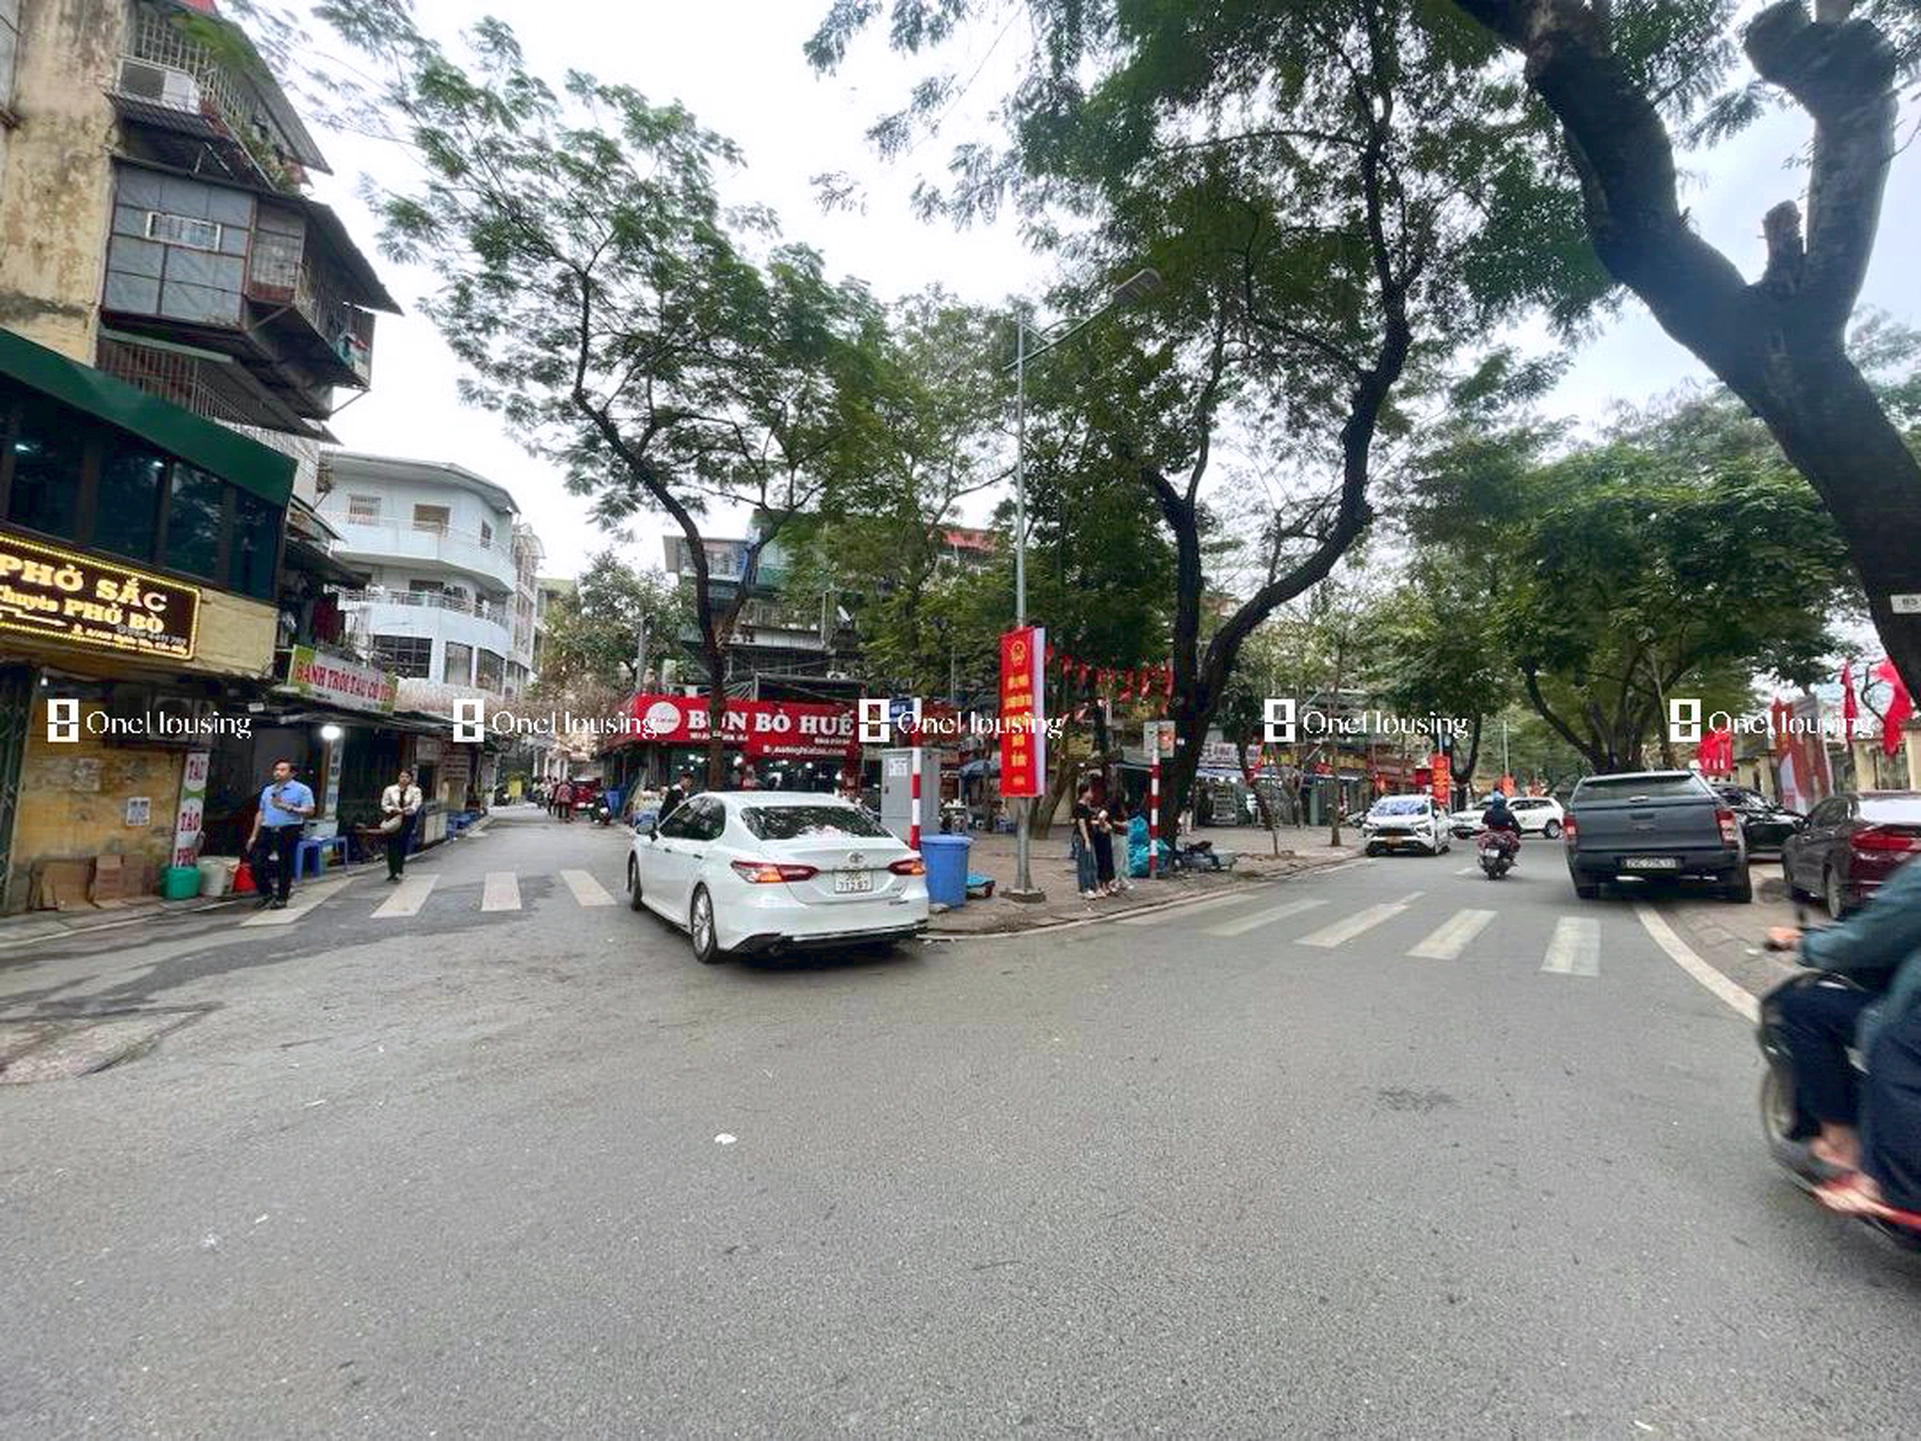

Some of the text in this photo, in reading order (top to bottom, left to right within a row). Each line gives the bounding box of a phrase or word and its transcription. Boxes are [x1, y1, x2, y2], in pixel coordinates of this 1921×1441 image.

[96, 577, 168, 612] SẮC
[128, 612, 165, 634] BÒ
[754, 708, 791, 733] BÒ
[799, 709, 855, 737] HUẾ
